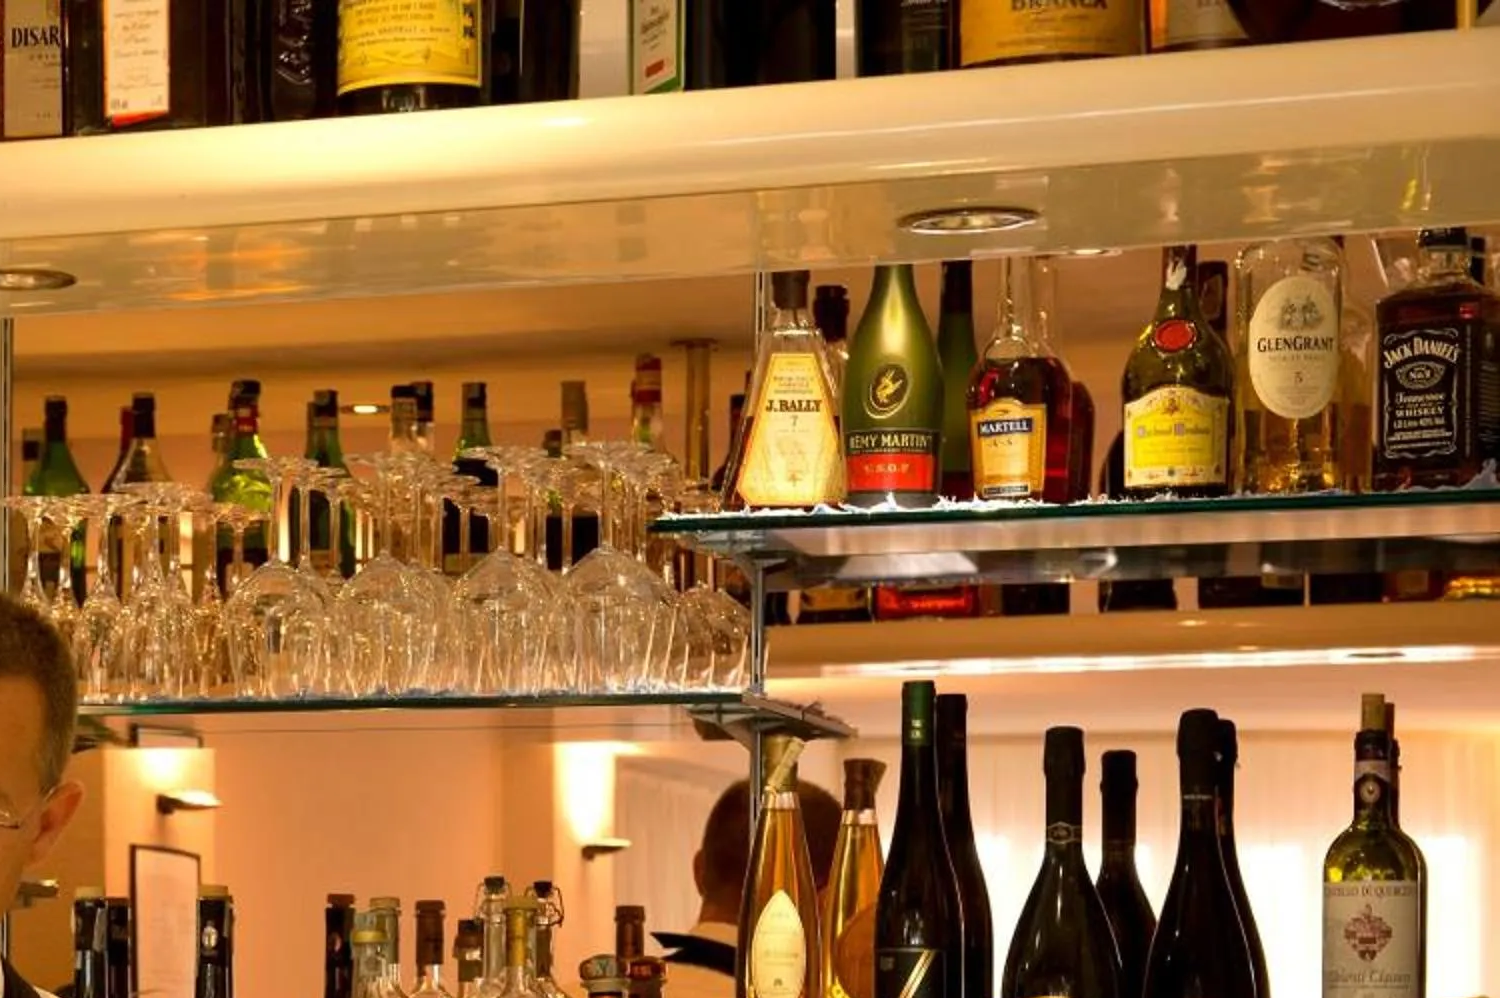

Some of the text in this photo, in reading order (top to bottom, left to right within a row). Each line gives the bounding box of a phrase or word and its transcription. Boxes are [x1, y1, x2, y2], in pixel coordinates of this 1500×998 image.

[1383, 343, 1413, 369] JACK
[981, 420, 1029, 433] MARTELL
[881, 432, 928, 448] MARTIN
